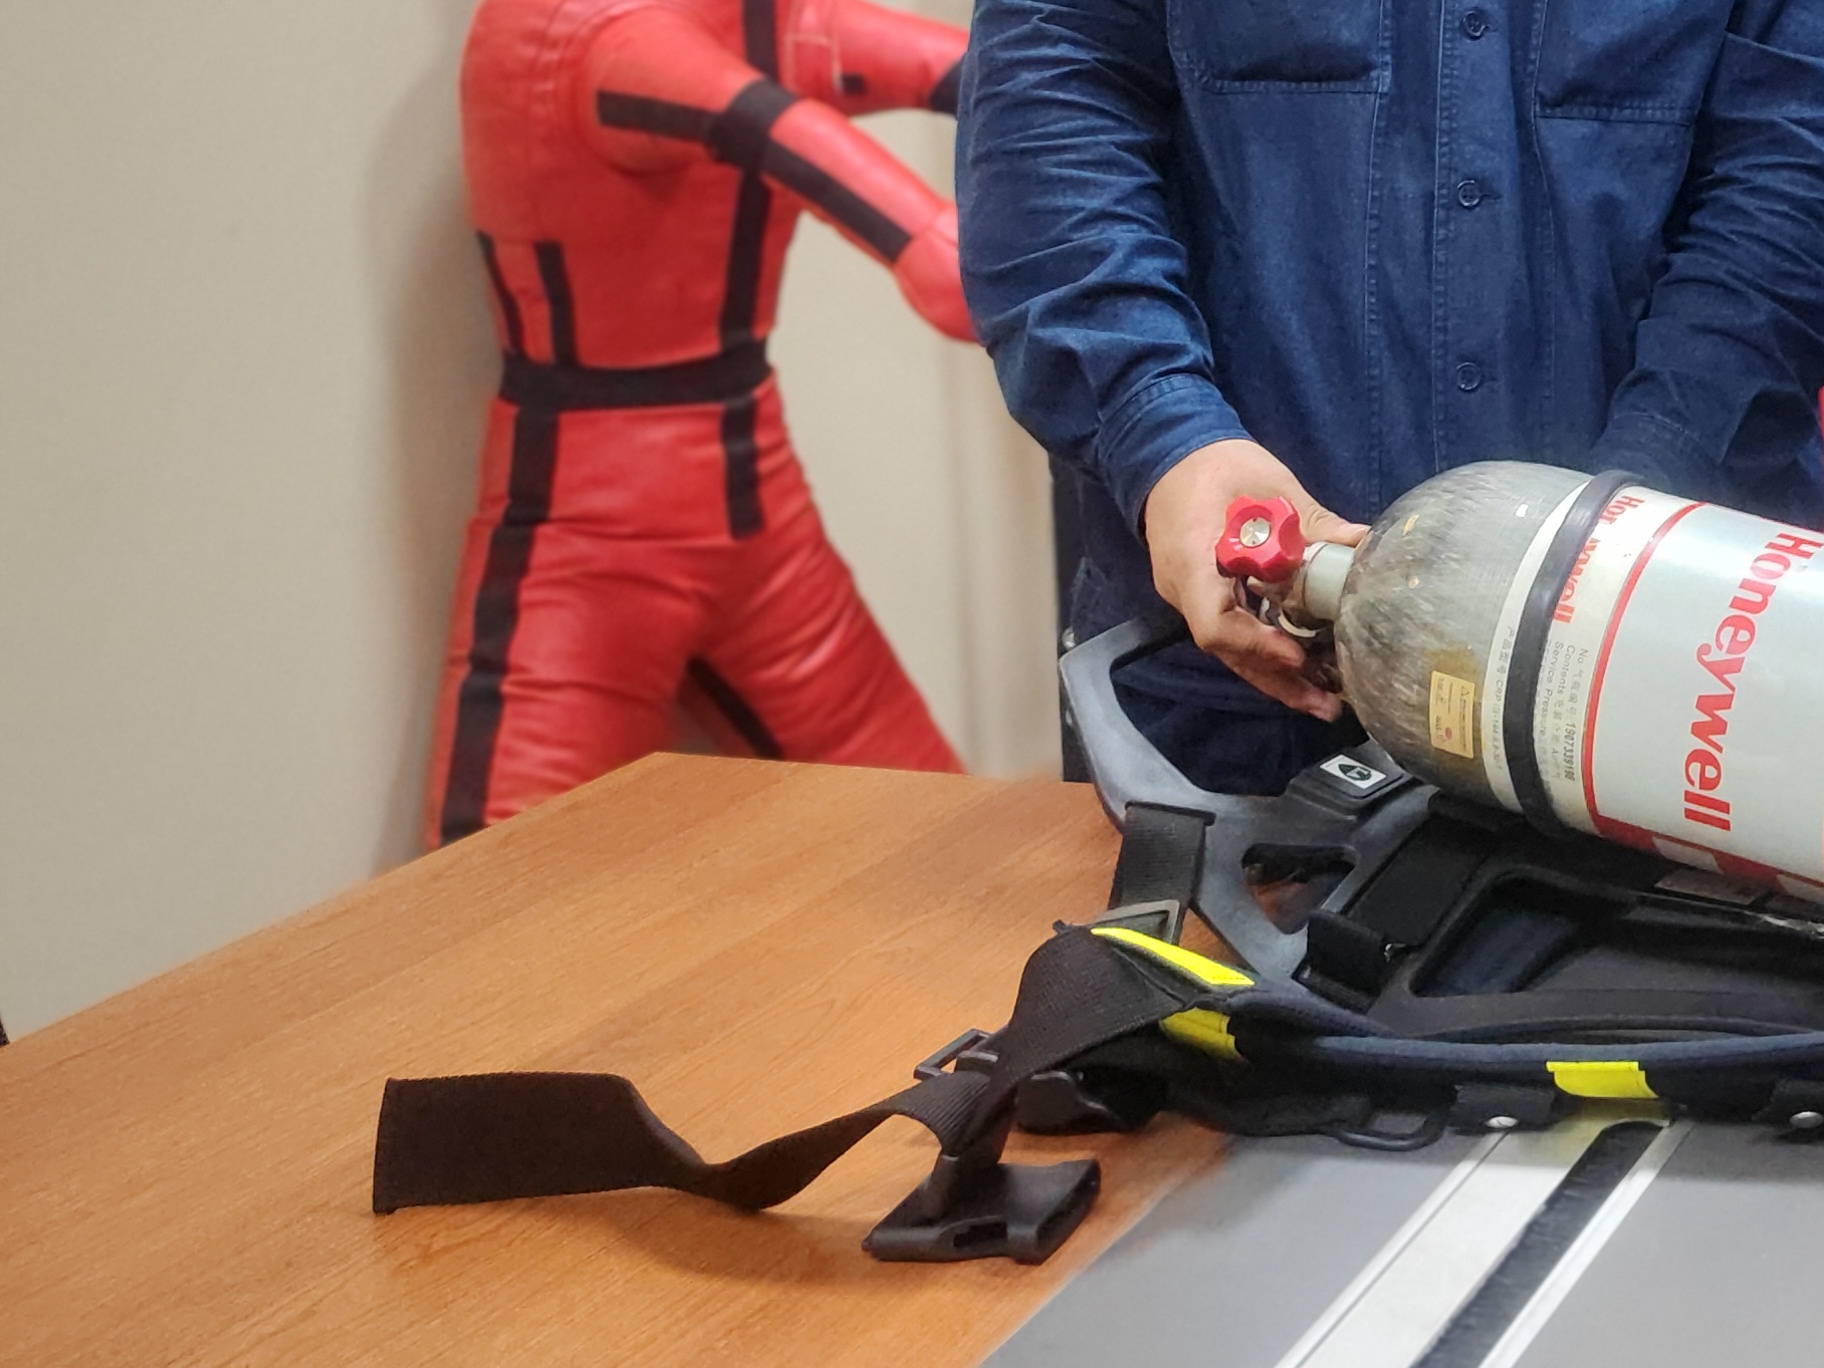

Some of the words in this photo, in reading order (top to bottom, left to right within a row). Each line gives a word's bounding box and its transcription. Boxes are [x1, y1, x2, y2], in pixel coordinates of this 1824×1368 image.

[1547, 640, 1564, 684] Service
[1557, 644, 1576, 695] Contents
[1684, 532, 1824, 832] Honeywell
[1539, 688, 1553, 737] Pressure
